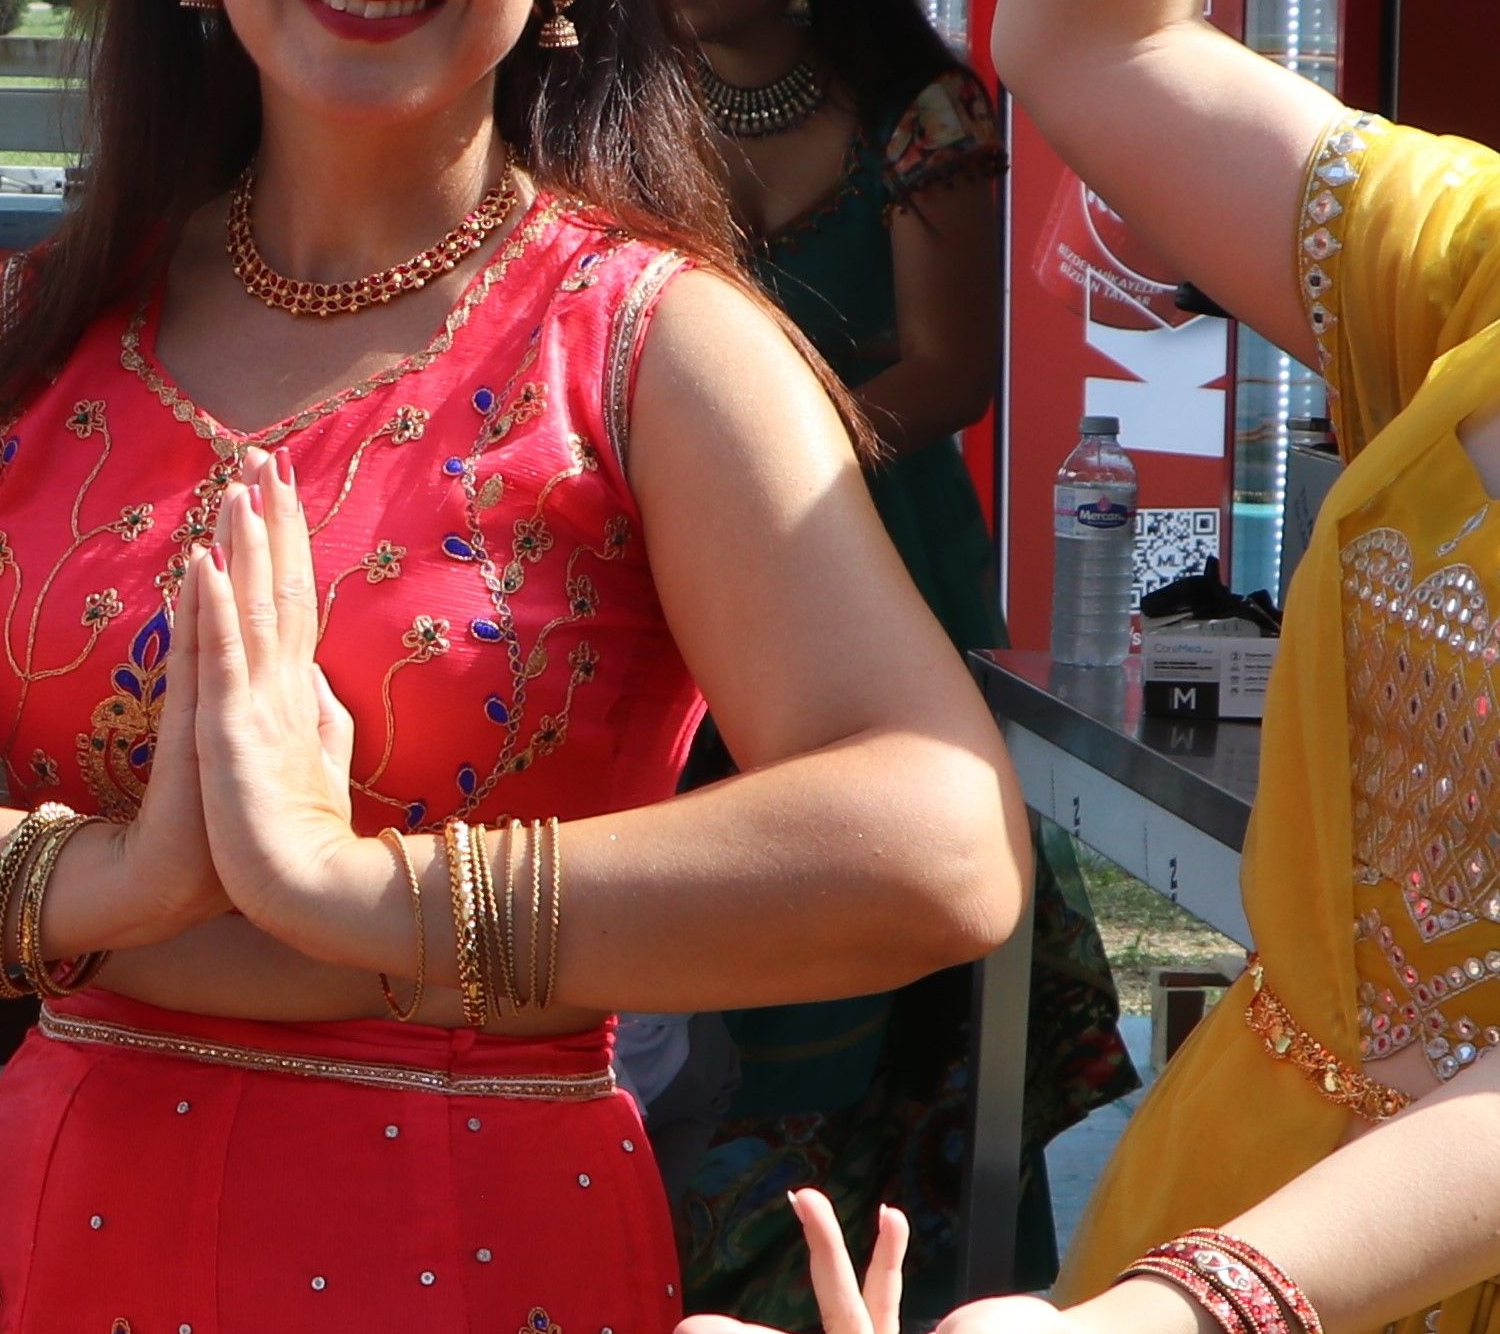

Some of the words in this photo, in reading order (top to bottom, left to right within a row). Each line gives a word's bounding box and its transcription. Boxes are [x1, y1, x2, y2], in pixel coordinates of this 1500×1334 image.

[1079, 510, 1121, 522] Mercan
[1157, 555, 1181, 567] ML
[1173, 687, 1197, 710] M
